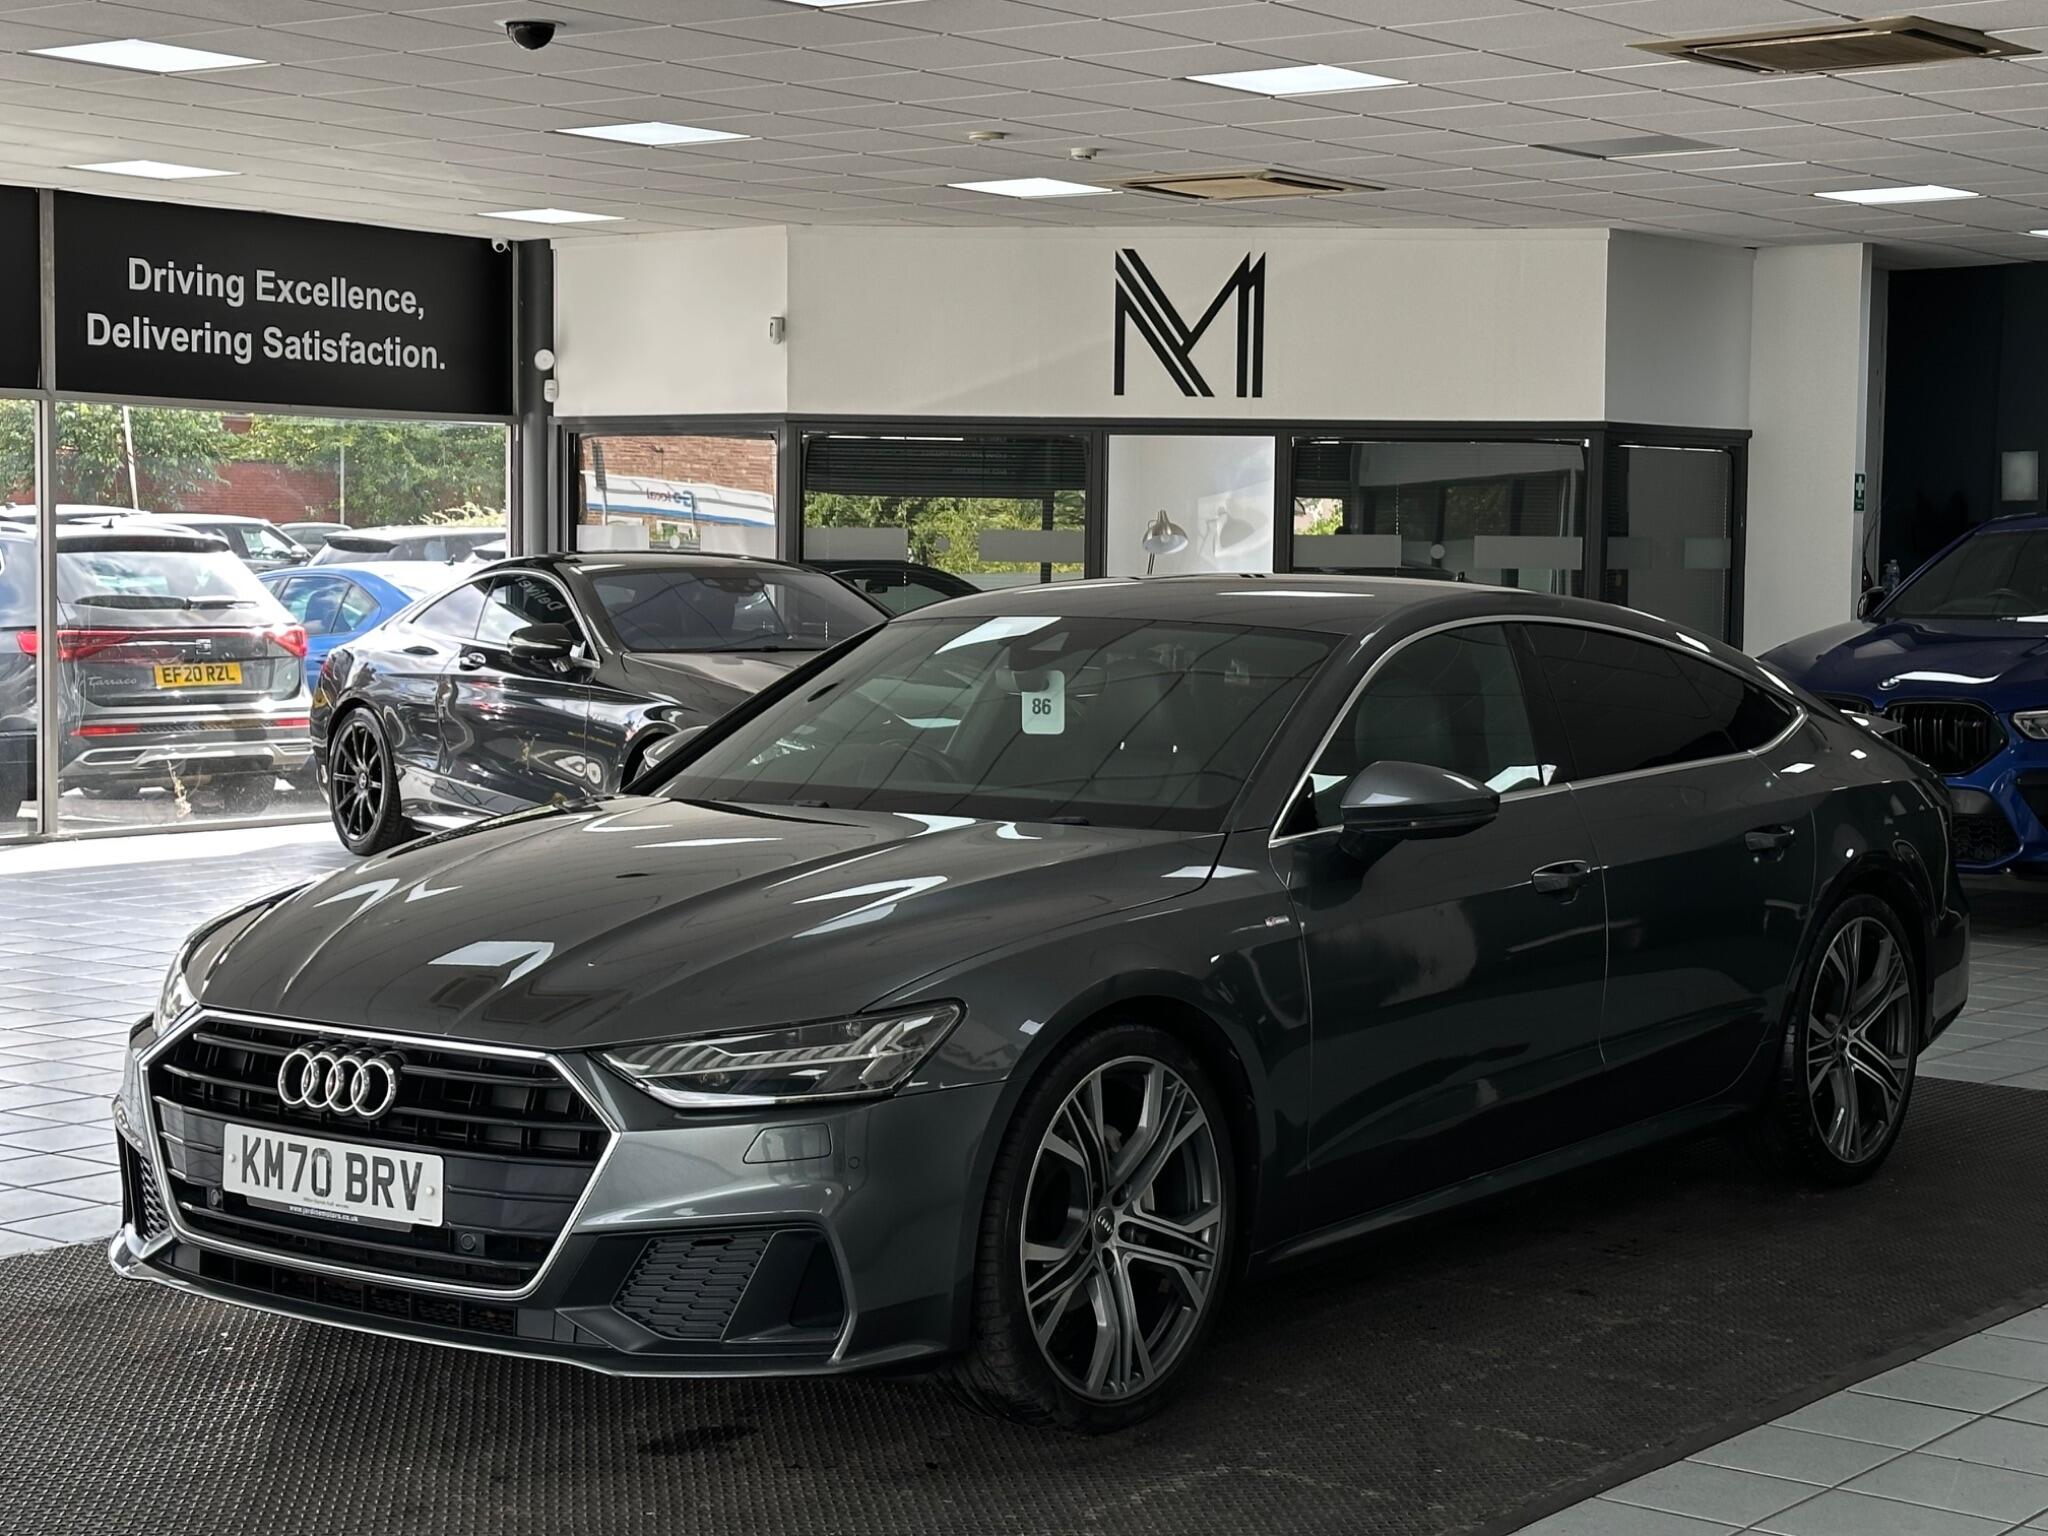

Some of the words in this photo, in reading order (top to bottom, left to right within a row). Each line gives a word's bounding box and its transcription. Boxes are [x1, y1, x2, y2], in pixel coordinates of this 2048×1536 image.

[128, 257, 244, 306] Driving
[256, 268, 424, 320] Excellence,
[86, 312, 252, 364] Delivering
[263, 326, 446, 370] Satisfaction.
[87, 676, 137, 687] Tarraco
[163, 666, 202, 683] EF20
[206, 665, 236, 681] RZL
[1032, 697, 1051, 715] 86
[241, 1134, 332, 1197] KM70
[345, 1152, 423, 1211] BRV
